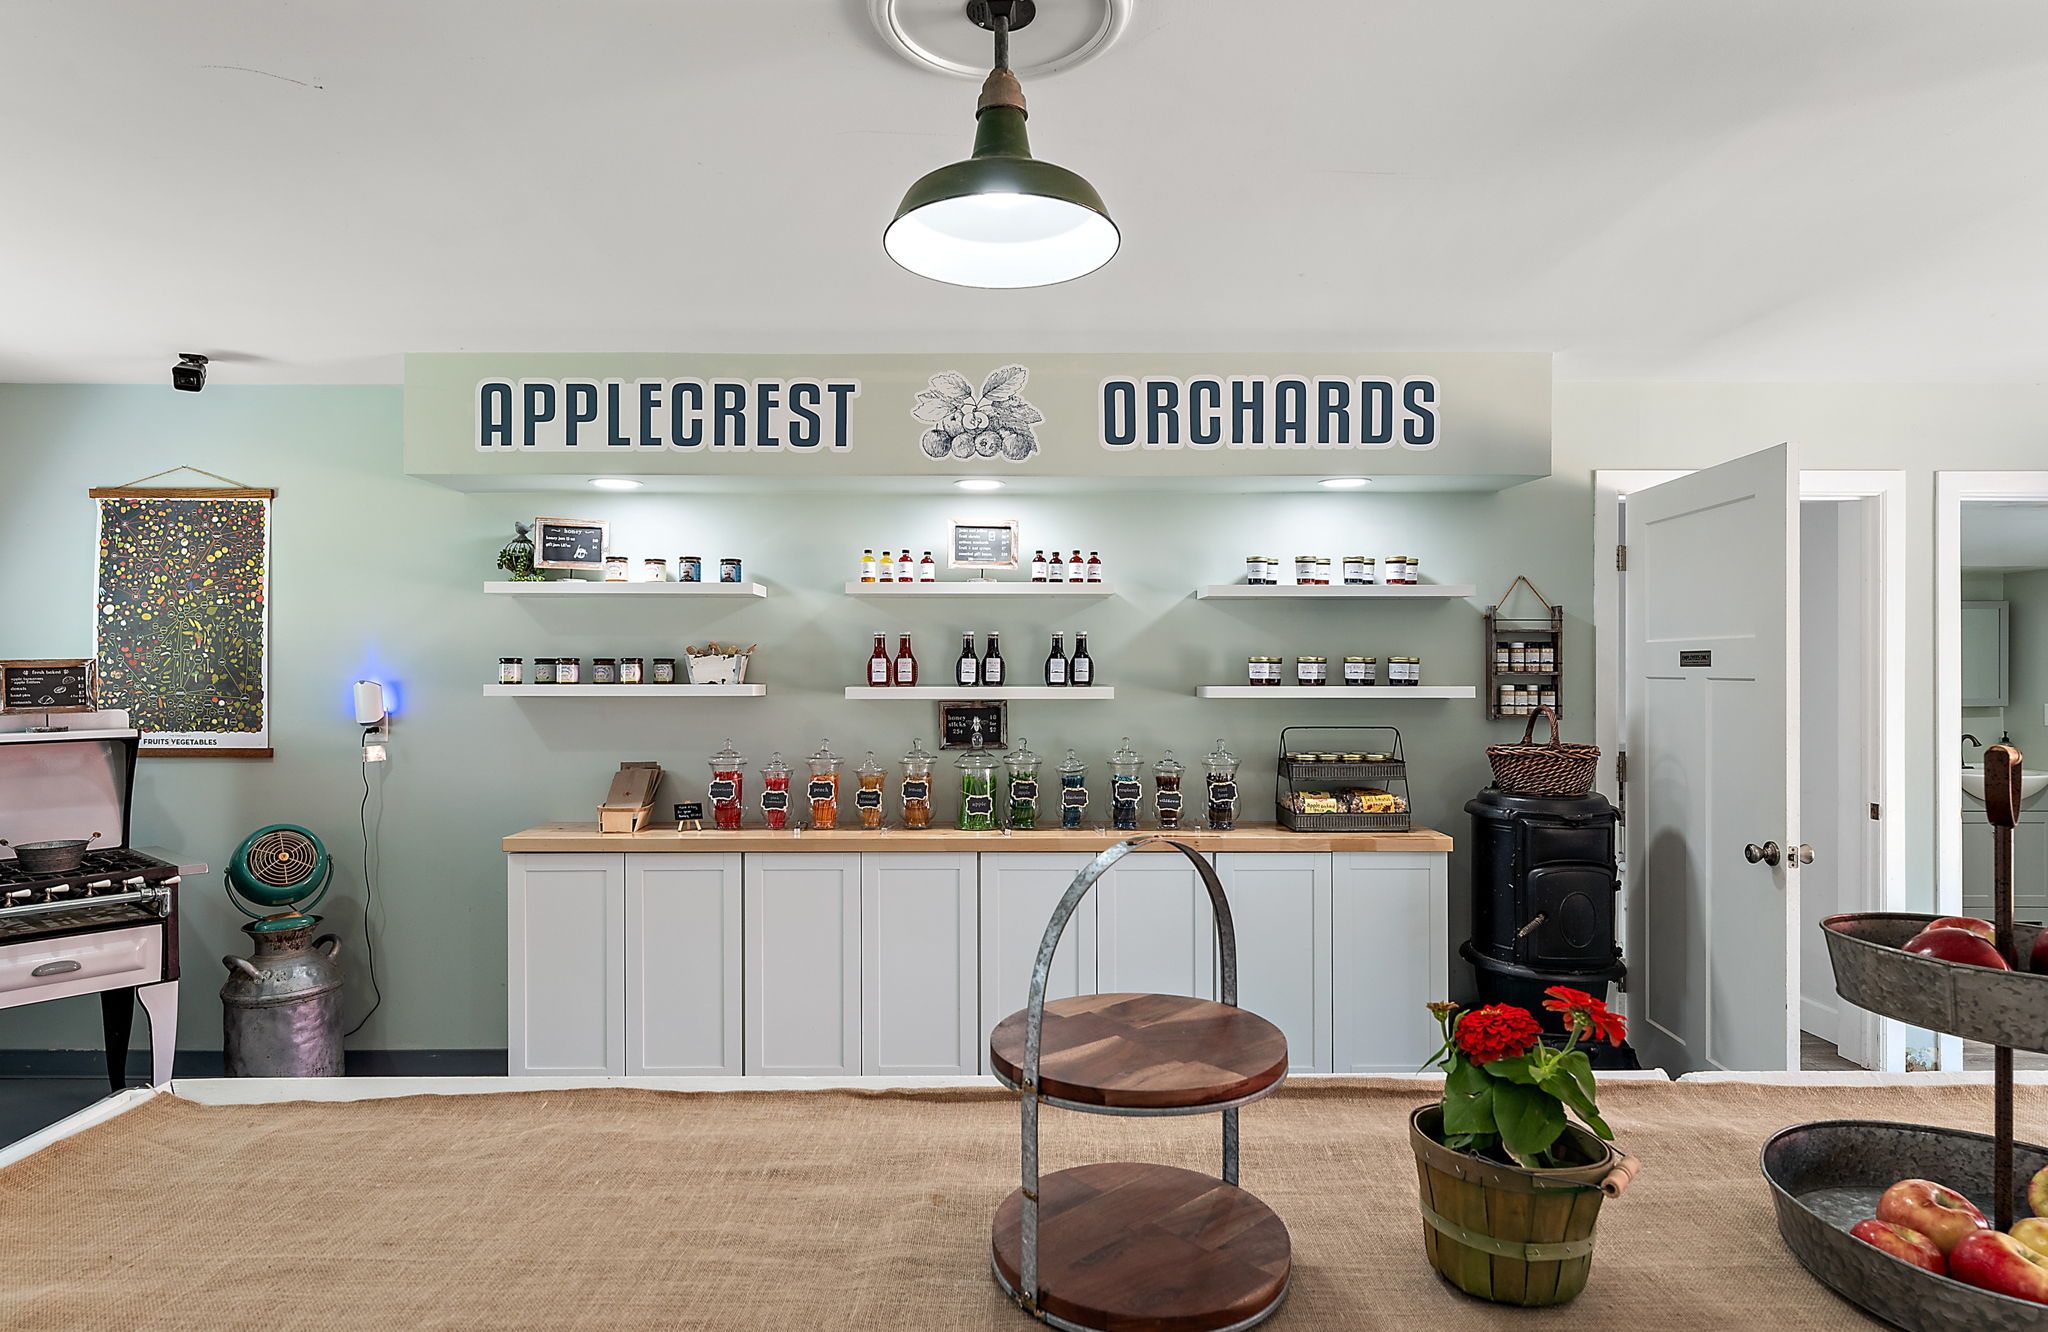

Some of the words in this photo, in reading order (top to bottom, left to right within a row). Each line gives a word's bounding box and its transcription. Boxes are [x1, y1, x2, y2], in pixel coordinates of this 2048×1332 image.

[480, 383, 856, 447] APPLECREST
[1104, 380, 1435, 445] ORCHARDS
[948, 714, 966, 722] honey
[171, 738, 217, 746] VEGETABLES
